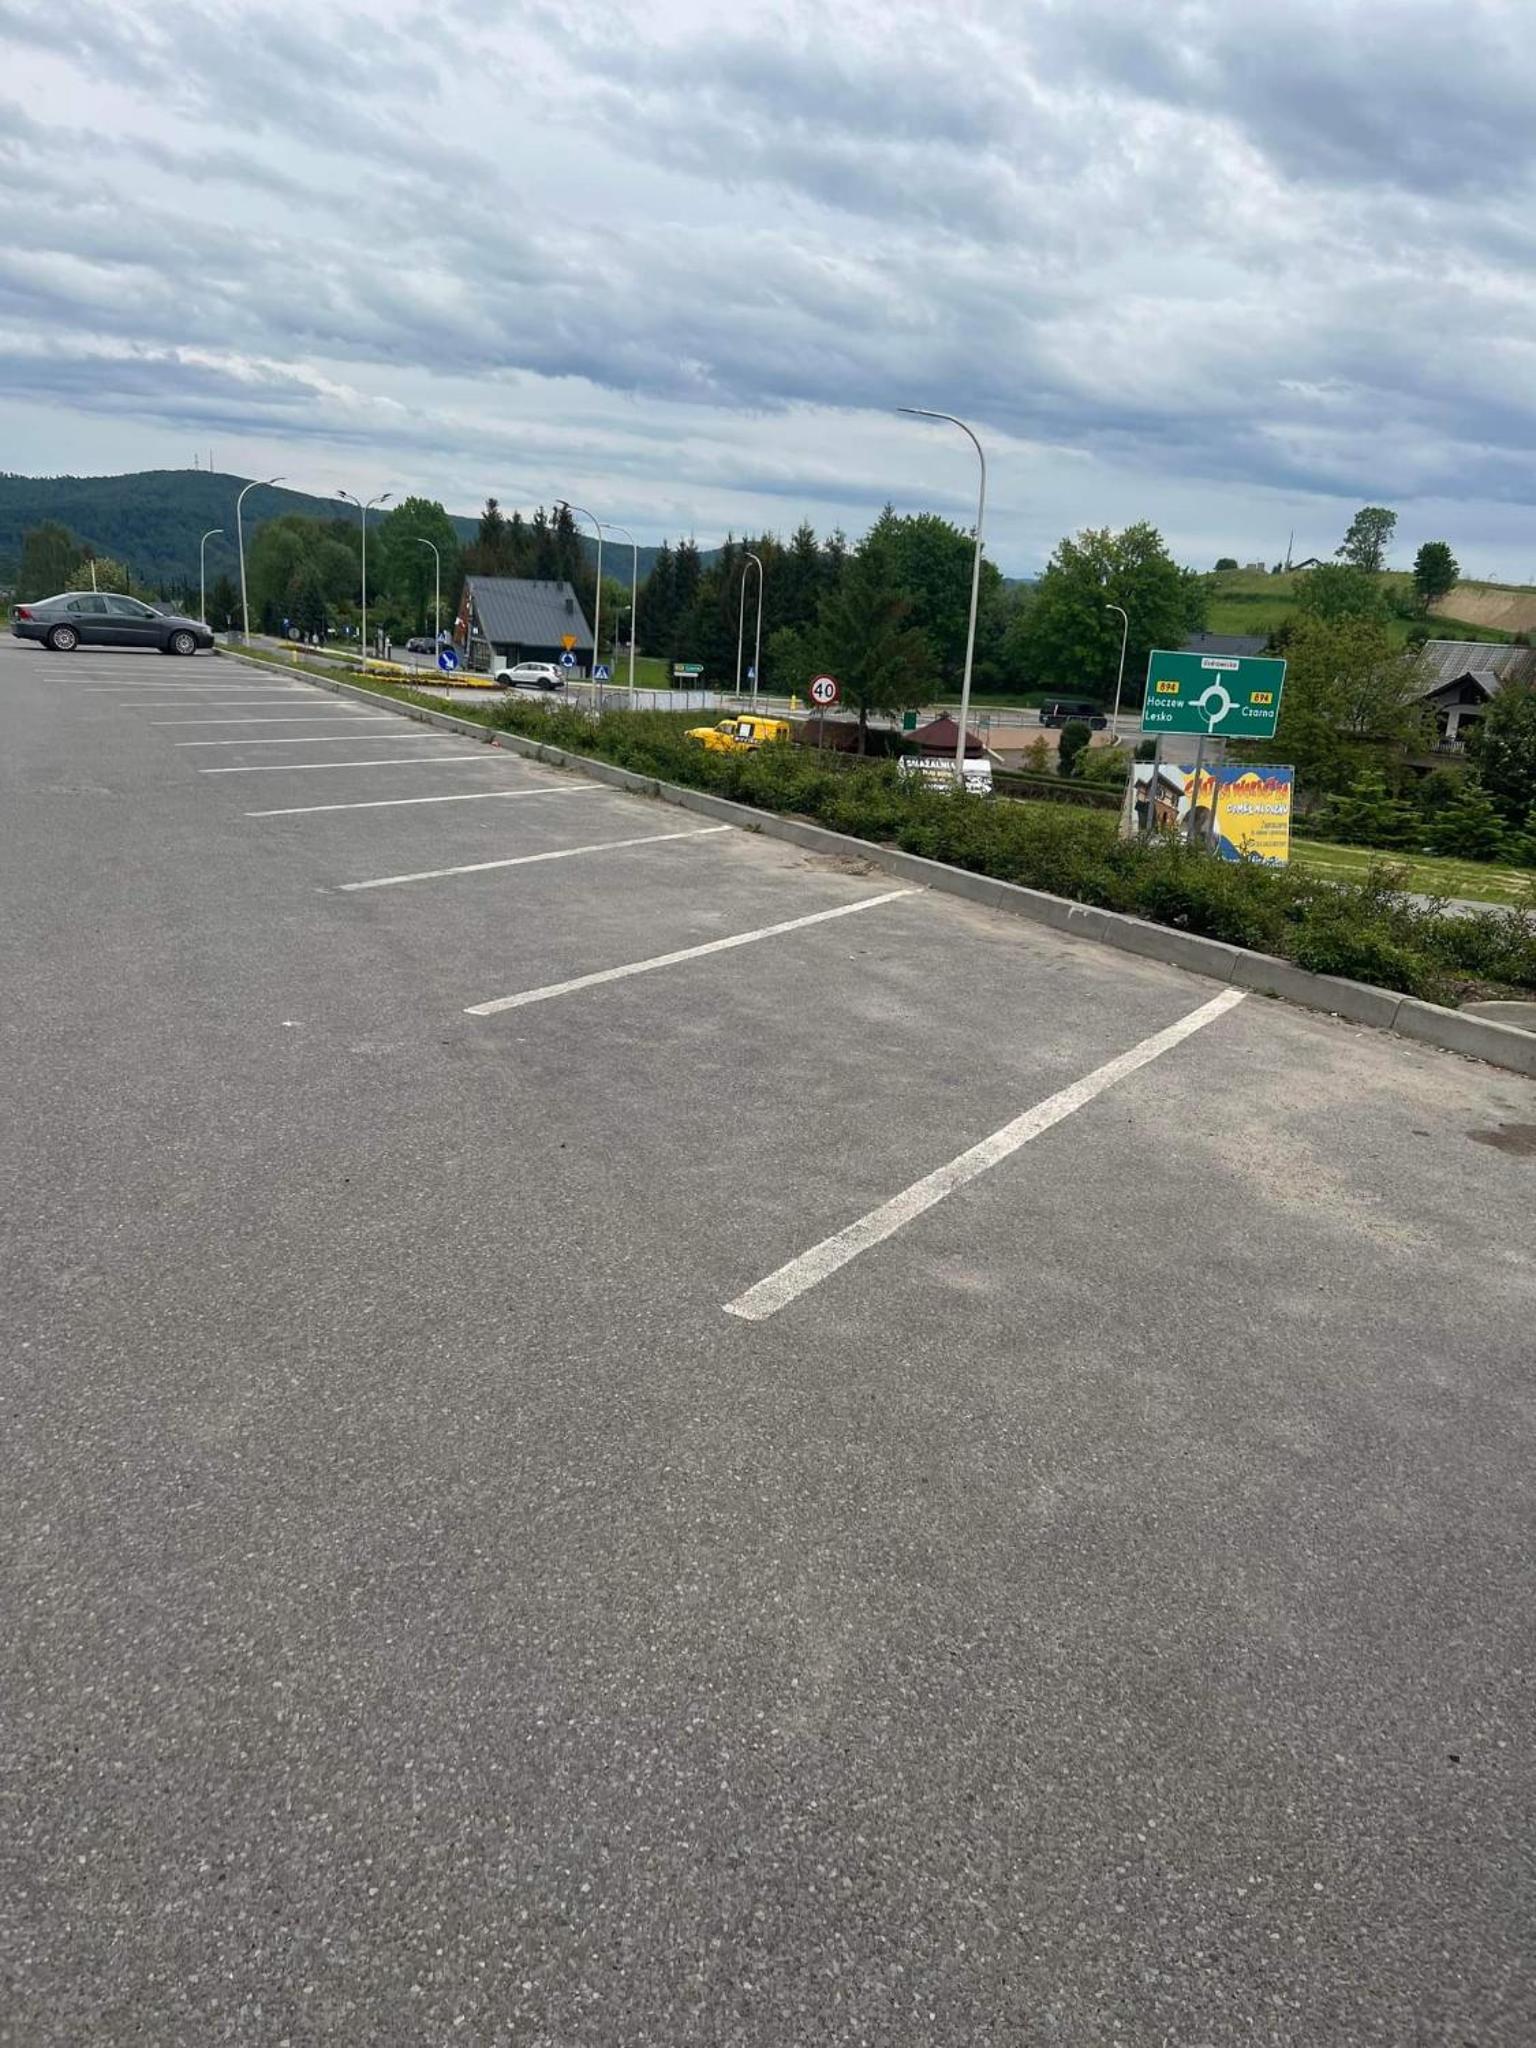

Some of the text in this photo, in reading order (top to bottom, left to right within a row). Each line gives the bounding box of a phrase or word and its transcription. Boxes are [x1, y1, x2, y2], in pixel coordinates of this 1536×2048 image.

[814, 683, 834, 698] 40
[1147, 696, 1184, 708] Hoczew
[1145, 710, 1173, 721] Lesko
[1242, 706, 1274, 717] Czarna
